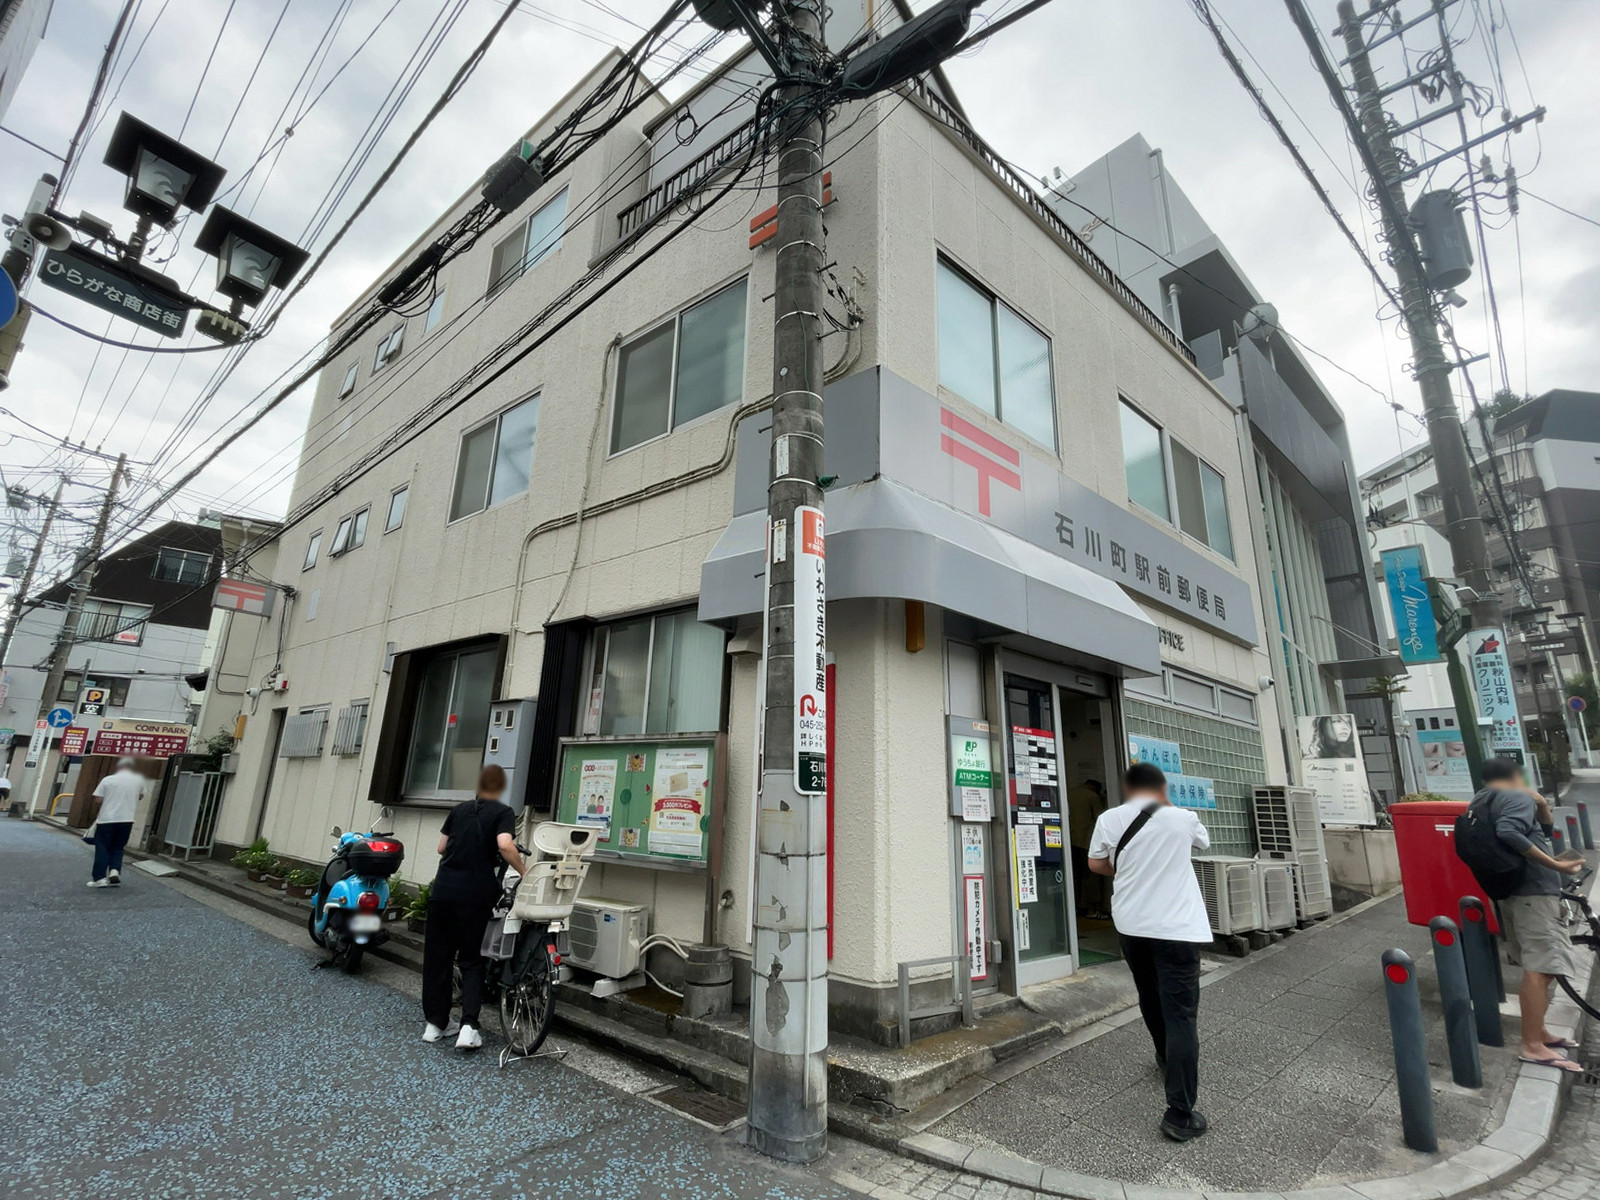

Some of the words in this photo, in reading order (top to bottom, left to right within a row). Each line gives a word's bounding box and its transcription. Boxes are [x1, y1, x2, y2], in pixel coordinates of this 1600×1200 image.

[46, 258, 182, 330] ひらがな商店街
[1054, 510, 1227, 622] 石川町駅前郵便局
[1478, 669, 1495, 717] クリニック
[1491, 667, 1510, 706] 秋山内科
[135, 724, 160, 733] COIN
[161, 727, 187, 735] PARK
[1140, 745, 1180, 765] かんぽの
[958, 771, 989, 781] ATMコーナー
